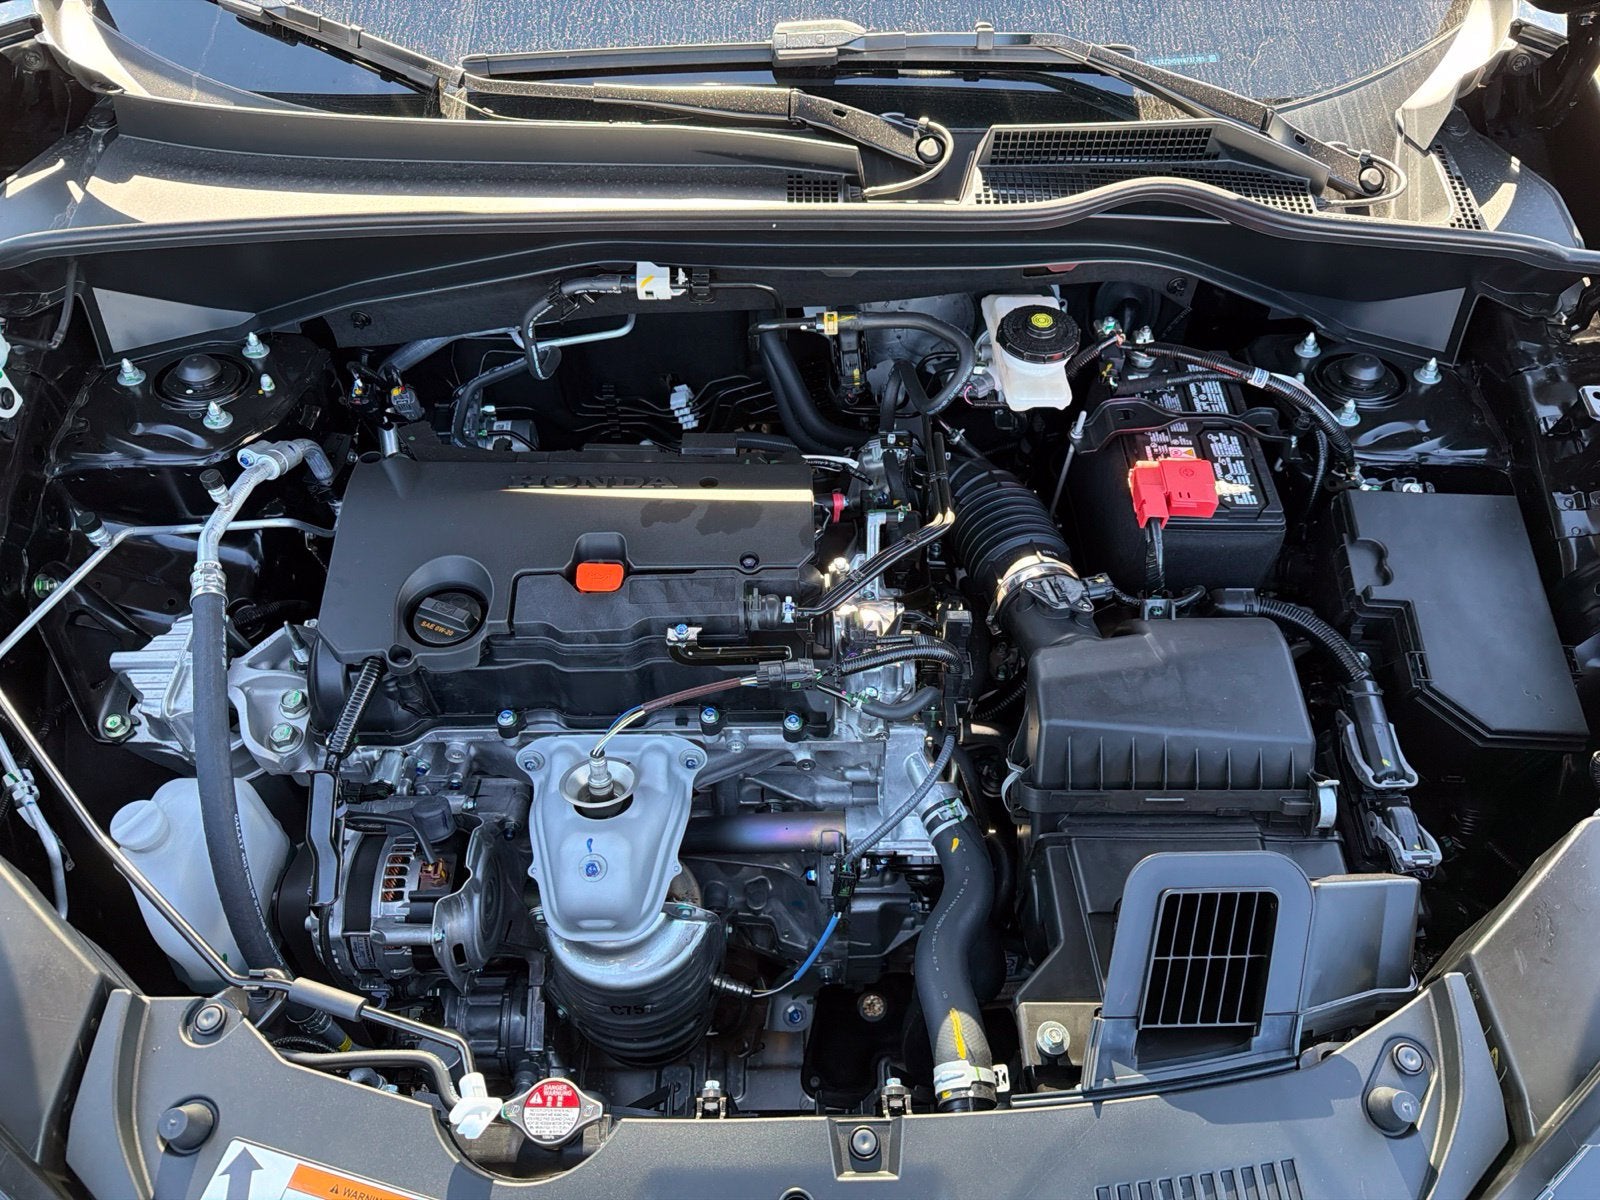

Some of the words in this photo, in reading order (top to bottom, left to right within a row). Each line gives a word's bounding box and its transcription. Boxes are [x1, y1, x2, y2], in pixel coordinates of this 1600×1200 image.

[508, 475, 679, 489] HONDA
[421, 621, 434, 630] SAE
[434, 625, 454, 636] 0W-20
